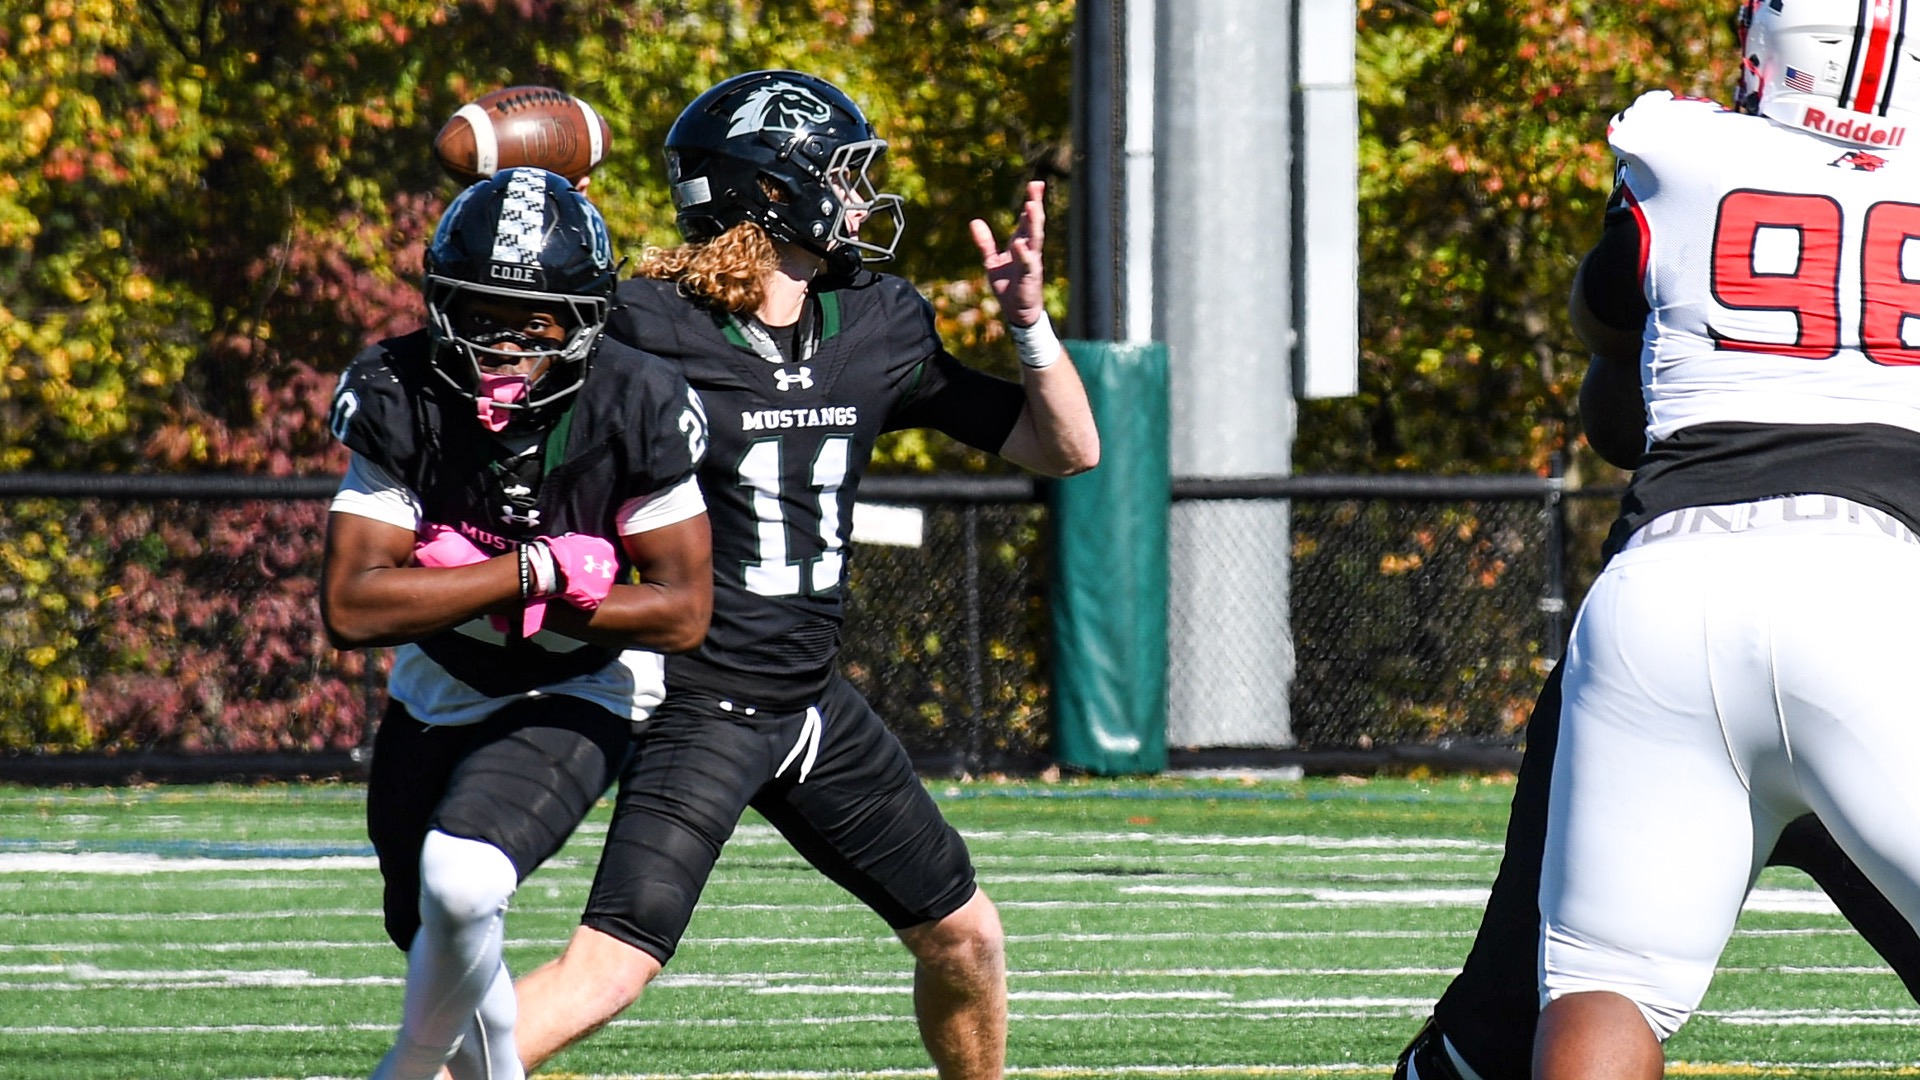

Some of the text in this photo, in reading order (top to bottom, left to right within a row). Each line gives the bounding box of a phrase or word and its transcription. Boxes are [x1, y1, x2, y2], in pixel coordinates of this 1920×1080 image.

[1803, 107, 1906, 147] Riddell
[741, 406, 858, 431] MUSTANGS
[735, 434, 854, 598] 11
[461, 520, 521, 552] MUST
